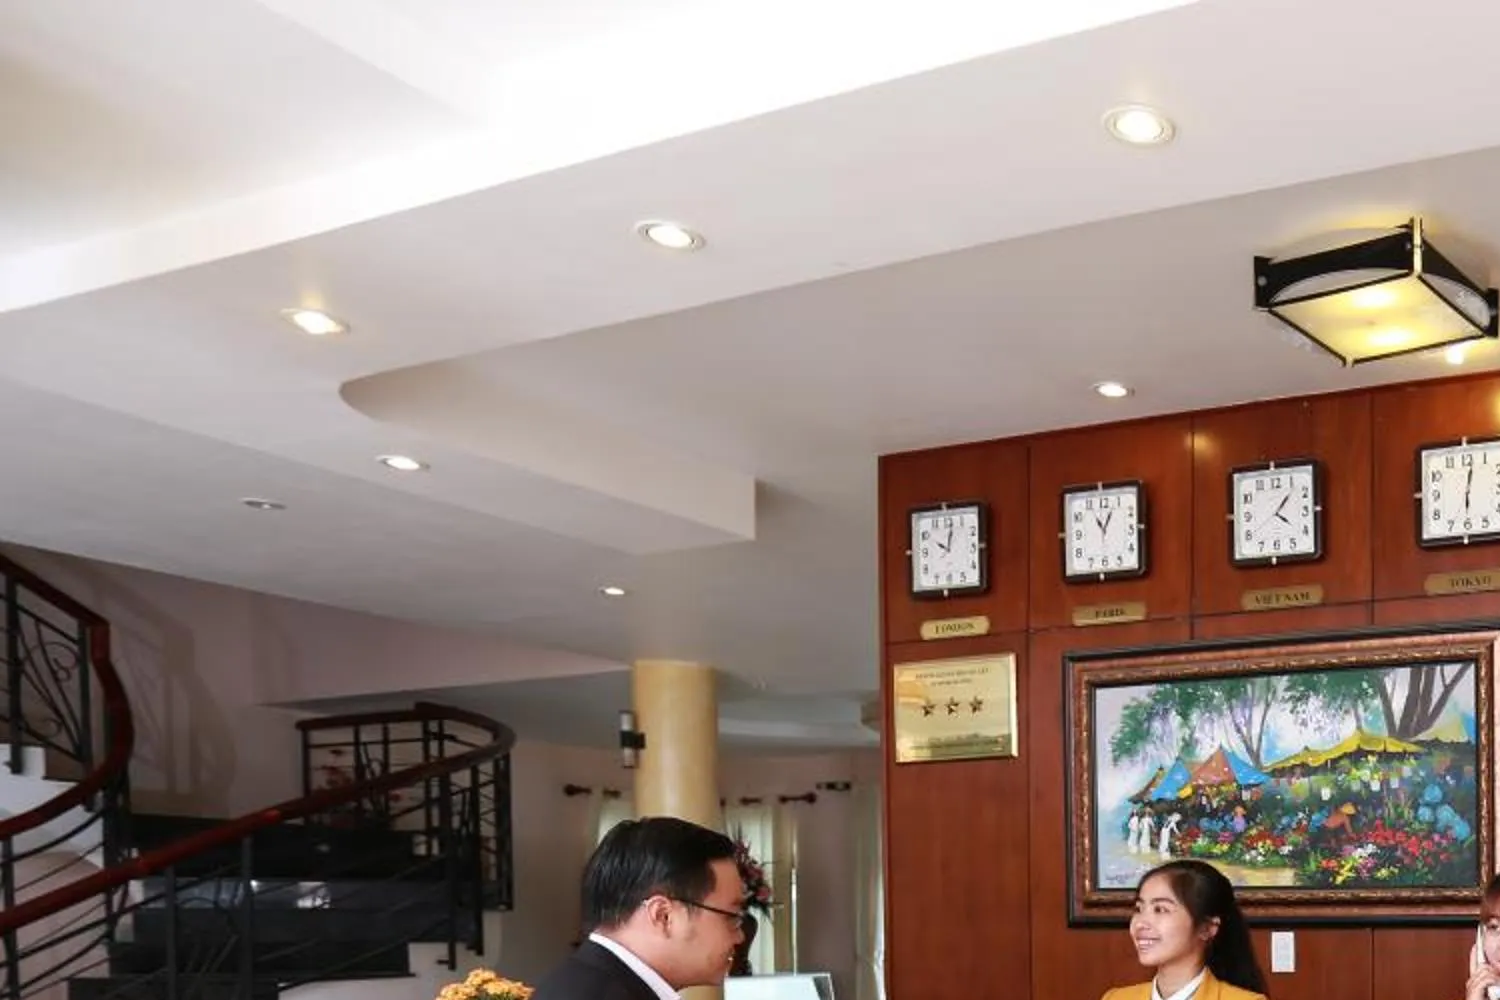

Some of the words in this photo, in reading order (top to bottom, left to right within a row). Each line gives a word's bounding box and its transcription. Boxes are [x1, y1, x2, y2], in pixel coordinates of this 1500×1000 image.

[1446, 456, 1454, 468] 11
[1462, 454, 1473, 466] 12
[1431, 470, 1443, 482] 10
[1255, 479, 1265, 491] 11
[1271, 477, 1281, 489] 12
[1301, 486, 1309, 498] 2
[1432, 489, 1440, 502] 9
[1243, 493, 1252, 504] 10
[1244, 512, 1252, 522] 9
[1301, 505, 1309, 517] 3
[1432, 509, 1440, 520] 8
[1447, 520, 1455, 532] 7
[1463, 518, 1472, 530] 6
[1481, 516, 1490, 529] 5
[1245, 530, 1252, 541] 8
[1302, 524, 1309, 536] 4
[1258, 541, 1265, 552] 7
[1273, 539, 1281, 550] 6
[1289, 538, 1296, 550] 5
[1448, 575, 1492, 588] TOKYO
